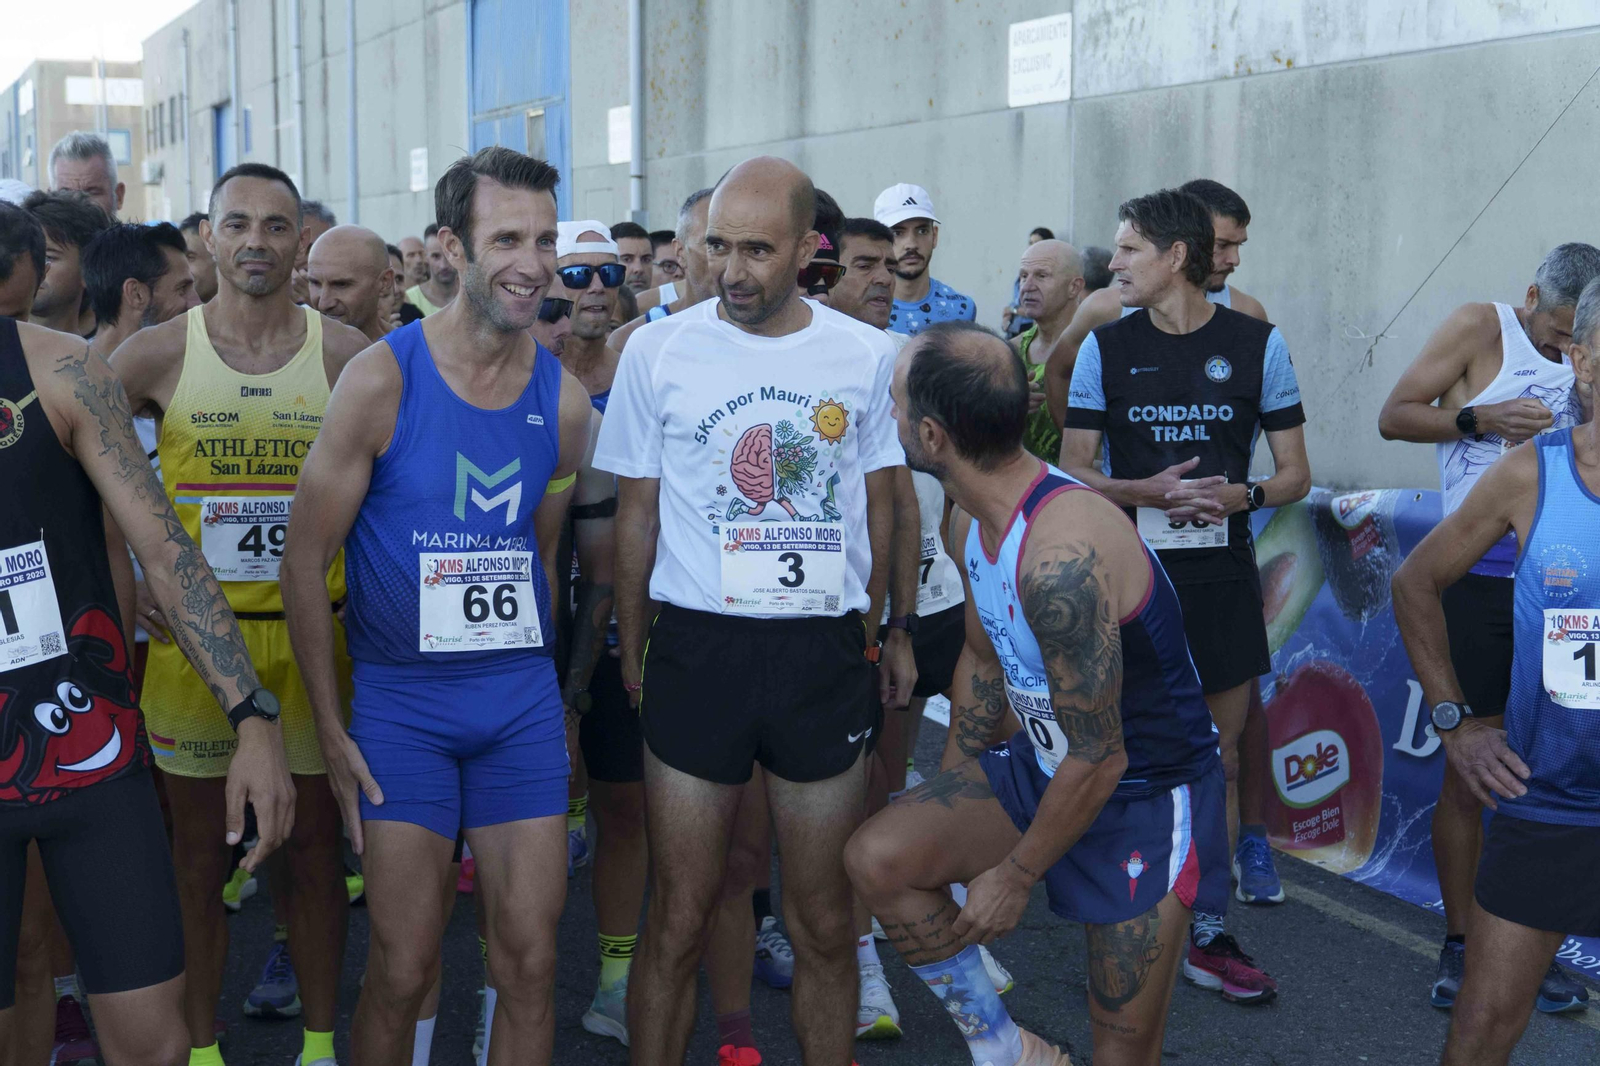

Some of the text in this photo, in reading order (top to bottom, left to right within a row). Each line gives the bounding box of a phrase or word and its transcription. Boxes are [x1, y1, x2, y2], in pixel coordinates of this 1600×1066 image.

[1513, 369, 1538, 377] 42K
[273, 410, 324, 423] San Lázaro
[694, 385, 812, 445] 5Km por Mauri
[1128, 404, 1234, 422] CONDADO
[211, 458, 299, 476] San Lázaro
[206, 502, 239, 514] 10KMS
[241, 501, 286, 514] ALFONSO
[238, 524, 288, 558] 49
[412, 529, 490, 549] MARINA
[726, 527, 842, 542] 10KMS ALFONSO MORO
[743, 543, 762, 551] VIGO,
[921, 537, 935, 549] ORO
[5, 548, 43, 573] MORO
[429, 559, 463, 573] KMS
[465, 557, 511, 573] ALFONSO
[13, 575, 25, 583] DE
[26, 569, 45, 580] 2026
[777, 551, 805, 588] 3
[444, 576, 463, 584] VIGO,
[481, 574, 514, 582] SETEMBRO
[463, 583, 519, 624] 66
[1550, 614, 1589, 630] 10KMS
[1568, 632, 1600, 641] VIGO, 13
[10, 656, 26, 665] ADN
[1284, 741, 1339, 785] Dole
[1292, 806, 1340, 833] Escoge Bien
[1294, 818, 1340, 843] Escoge Dole
